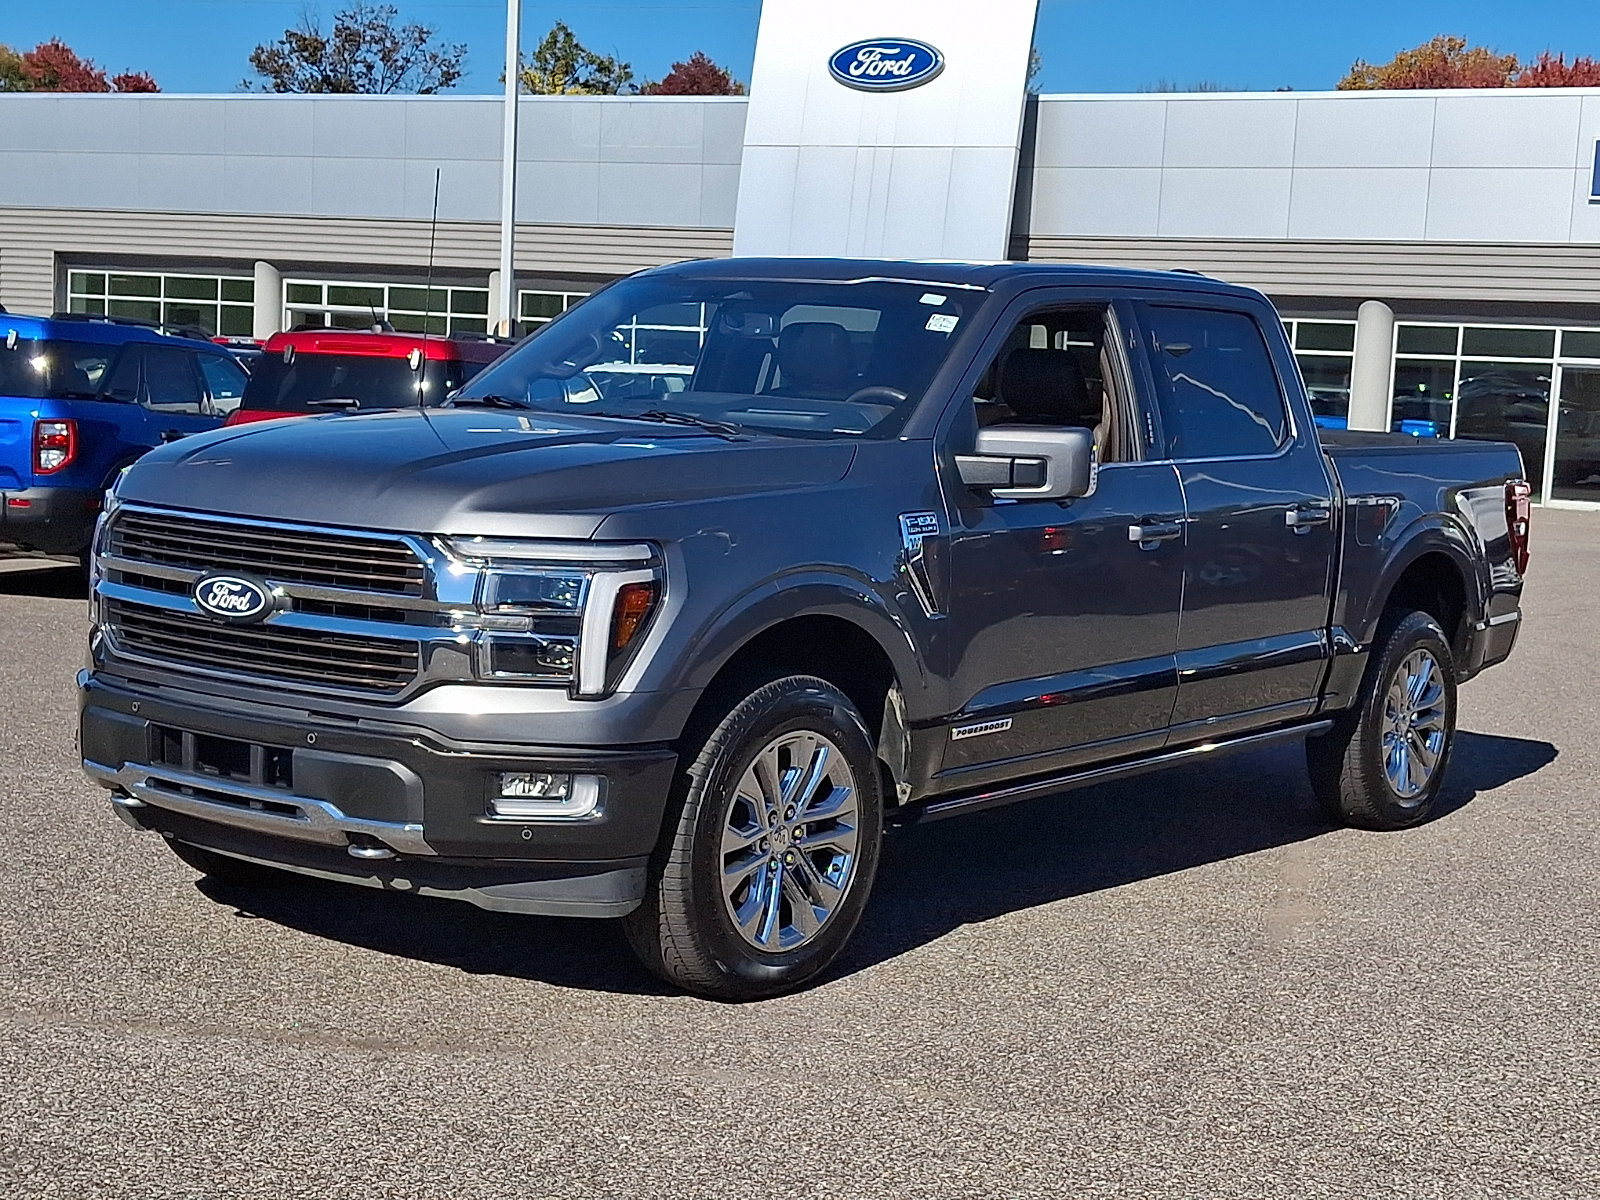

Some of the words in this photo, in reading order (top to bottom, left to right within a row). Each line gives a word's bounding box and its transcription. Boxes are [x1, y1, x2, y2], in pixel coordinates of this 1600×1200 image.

[849, 47, 916, 76] Ford
[208, 581, 252, 611] Ford
[956, 720, 1010, 737] POWERBOOST
